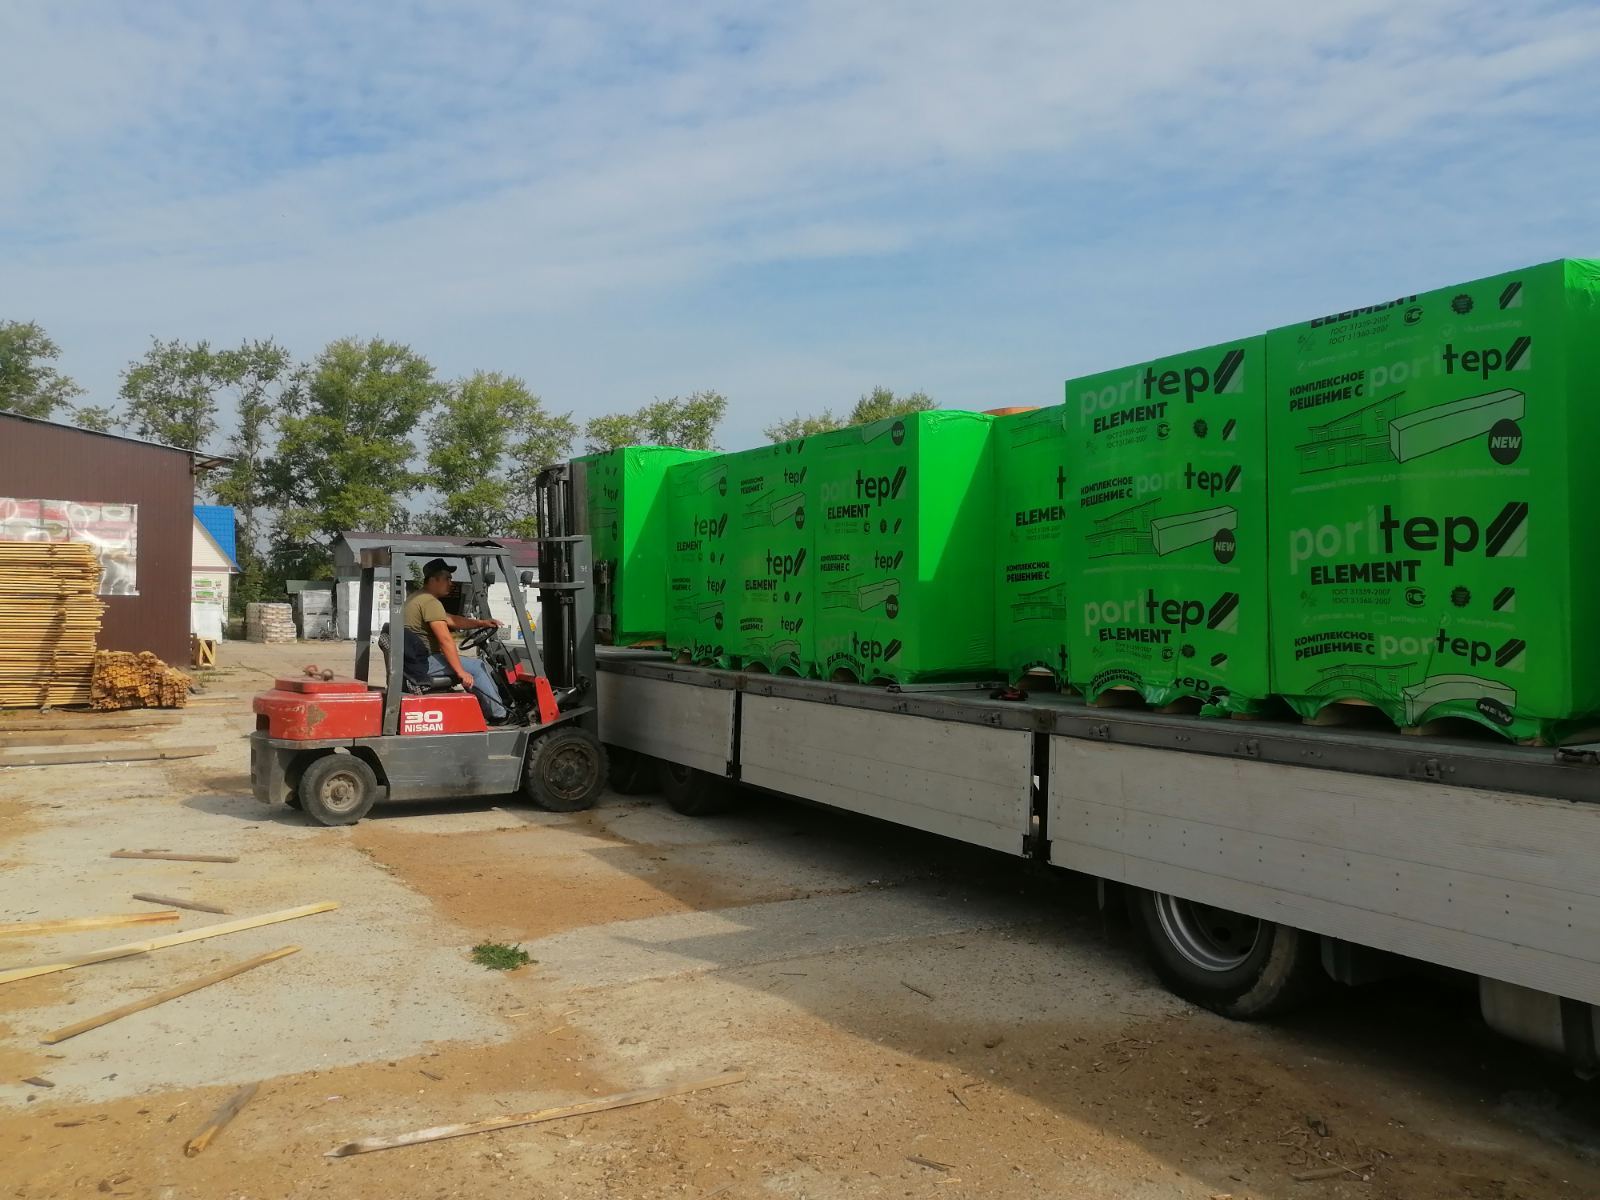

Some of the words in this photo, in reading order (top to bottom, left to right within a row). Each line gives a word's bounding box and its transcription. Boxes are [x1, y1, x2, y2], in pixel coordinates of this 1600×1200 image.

[1289, 370, 1365, 397] КОМПЛЕКСНОЕ
[1289, 387, 1351, 412] РЕШЕНИЕ
[1093, 402, 1169, 434] ELEMENT
[1491, 436, 1521, 449] NEW
[1080, 476, 1133, 496] КОМПЛЕКСНОЕ
[1081, 489, 1125, 508] РЕШЕНИЕ
[827, 503, 871, 520] ELEMENT
[1016, 505, 1067, 527] ELEMEN
[1214, 541, 1235, 552] NEW
[1310, 560, 1421, 586] ELEMENT
[745, 579, 778, 591] ELEMENT
[1099, 627, 1172, 644] ELEMENT
[1294, 630, 1375, 647] КОМПЛЕКСНОЕ
[1295, 642, 1363, 661] РЕШЕНИЕ
[405, 711, 443, 724] 30
[405, 724, 443, 733] NISSAN
